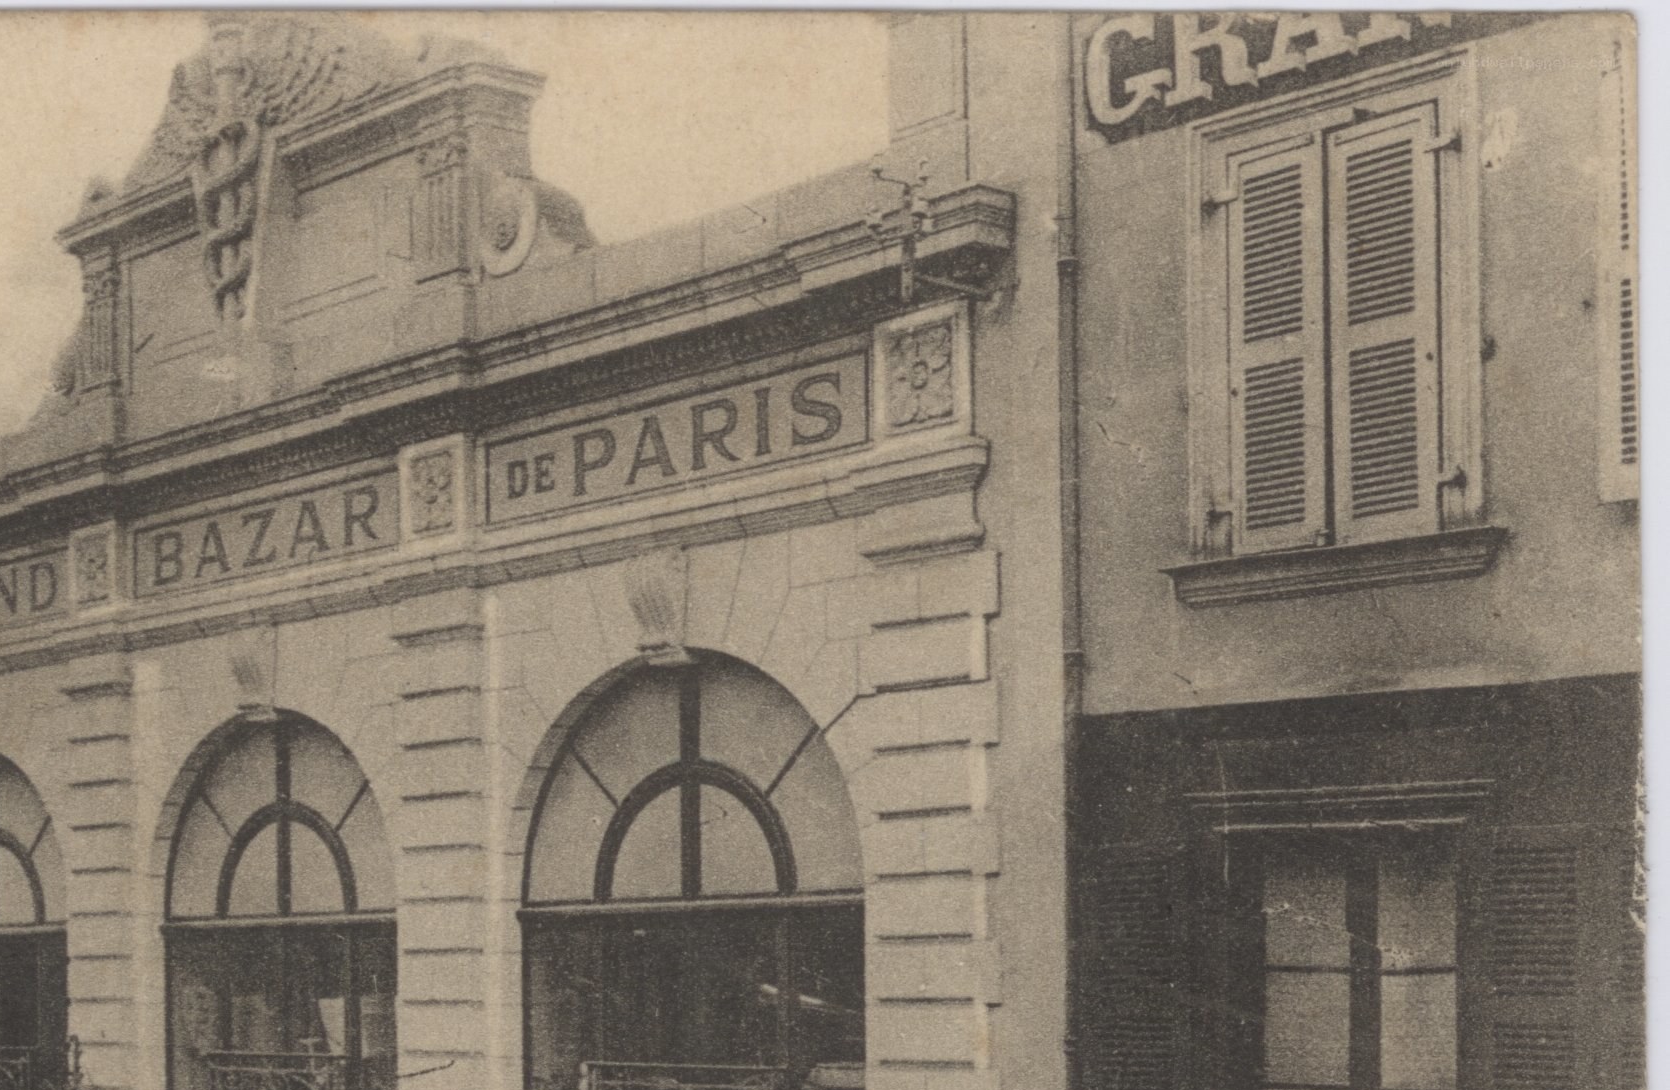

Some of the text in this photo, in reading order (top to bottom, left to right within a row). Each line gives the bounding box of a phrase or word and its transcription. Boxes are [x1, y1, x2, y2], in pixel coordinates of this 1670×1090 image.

[1086, 12, 1452, 126] GRA
[152, 488, 381, 587] BAZAR
[506, 453, 556, 500] DE
[572, 372, 843, 498] PARIS
